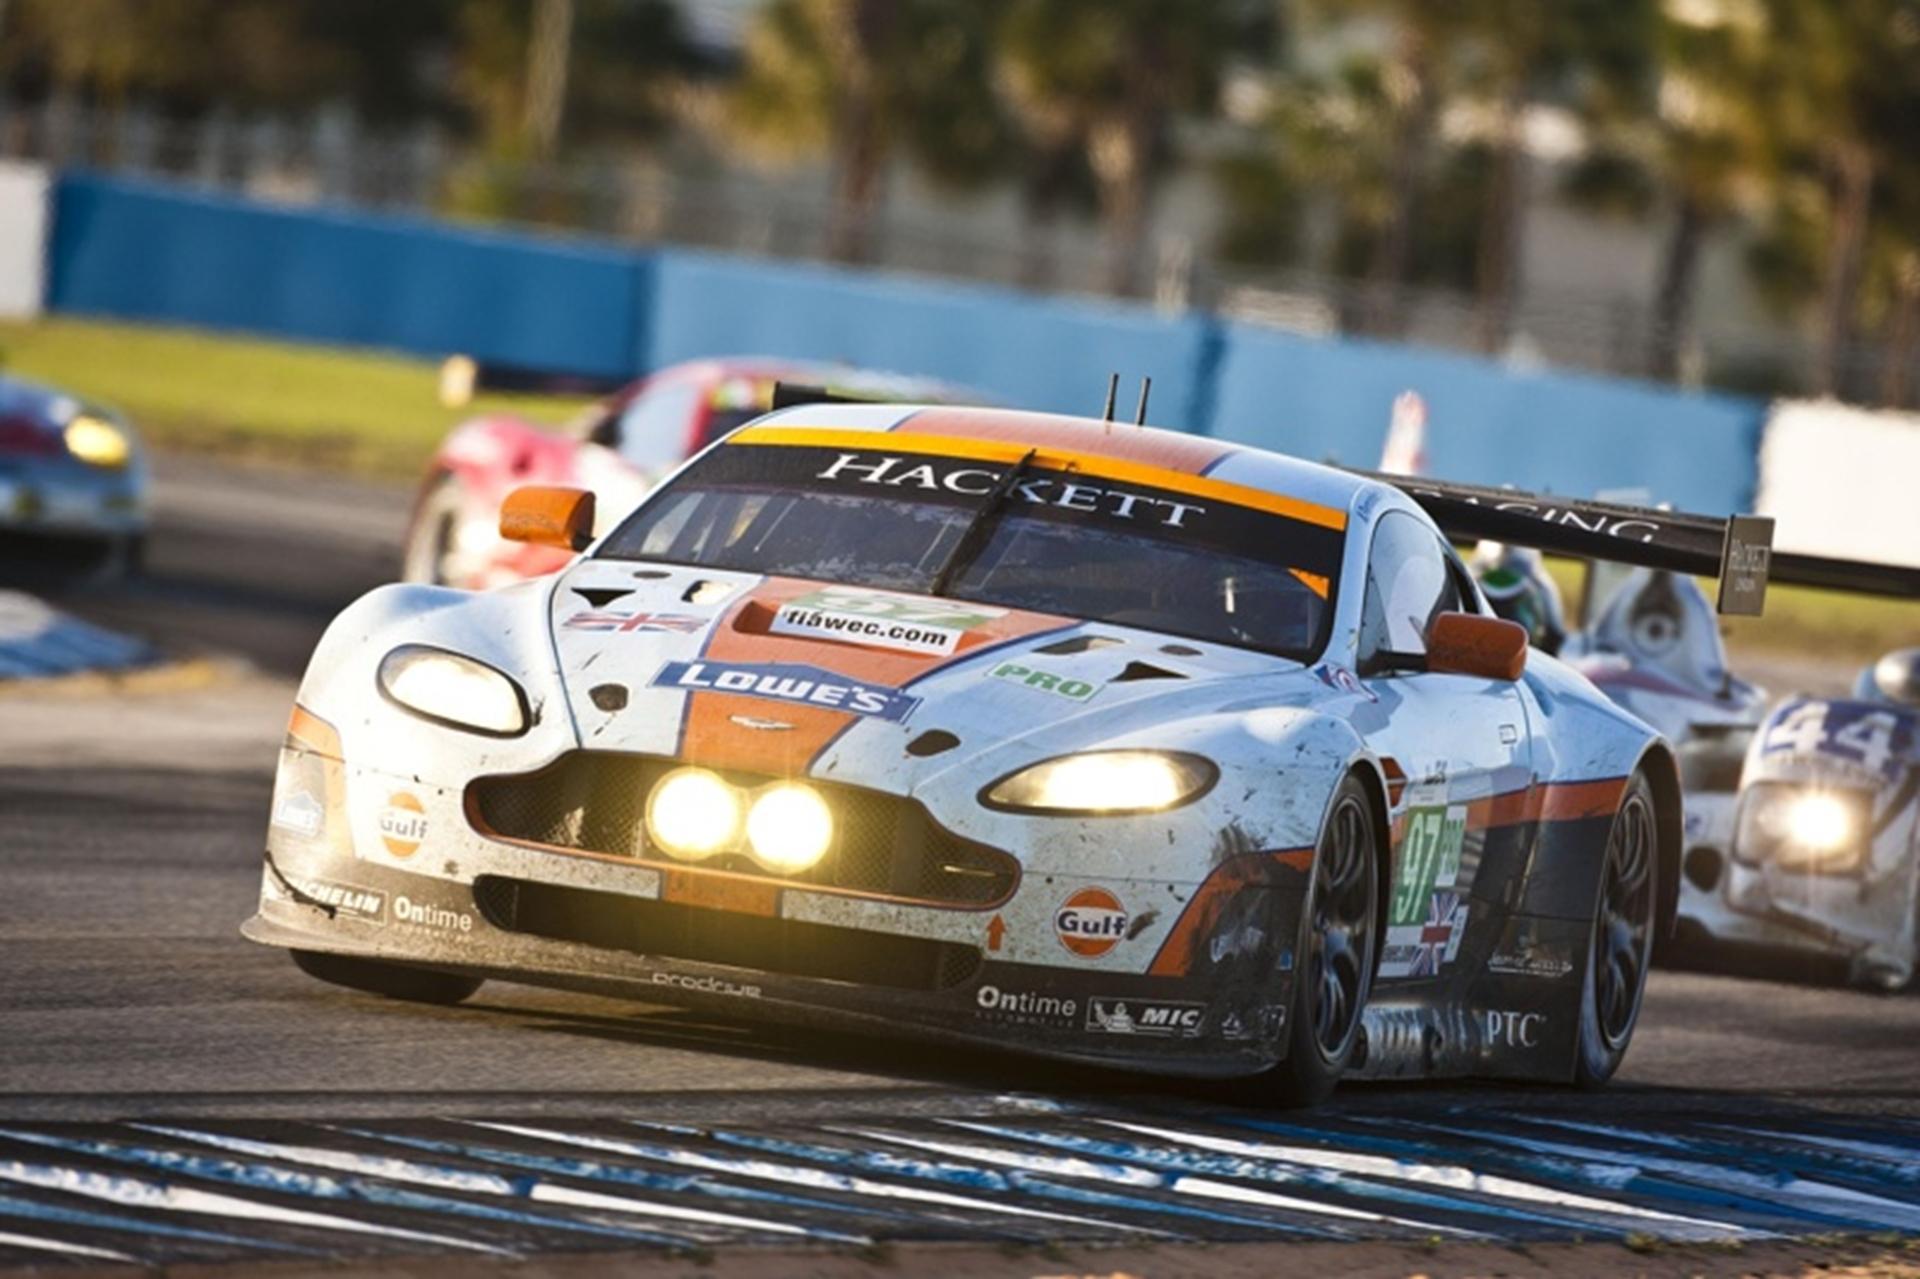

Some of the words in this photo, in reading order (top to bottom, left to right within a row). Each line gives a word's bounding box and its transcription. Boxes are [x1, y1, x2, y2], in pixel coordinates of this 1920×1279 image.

[816, 454, 1206, 527] HACKETT
[785, 609, 949, 646] fiawec.com
[678, 663, 889, 713] LOWE'S
[993, 664, 1093, 698] PRO
[1766, 701, 1898, 772] 44
[380, 810, 428, 838] Gulf
[1395, 812, 1443, 924] 97
[394, 896, 473, 932] Ontime
[1058, 911, 1126, 936] Gulf
[976, 985, 1077, 1017] Ontime
[1487, 1010, 1540, 1047] PTC
